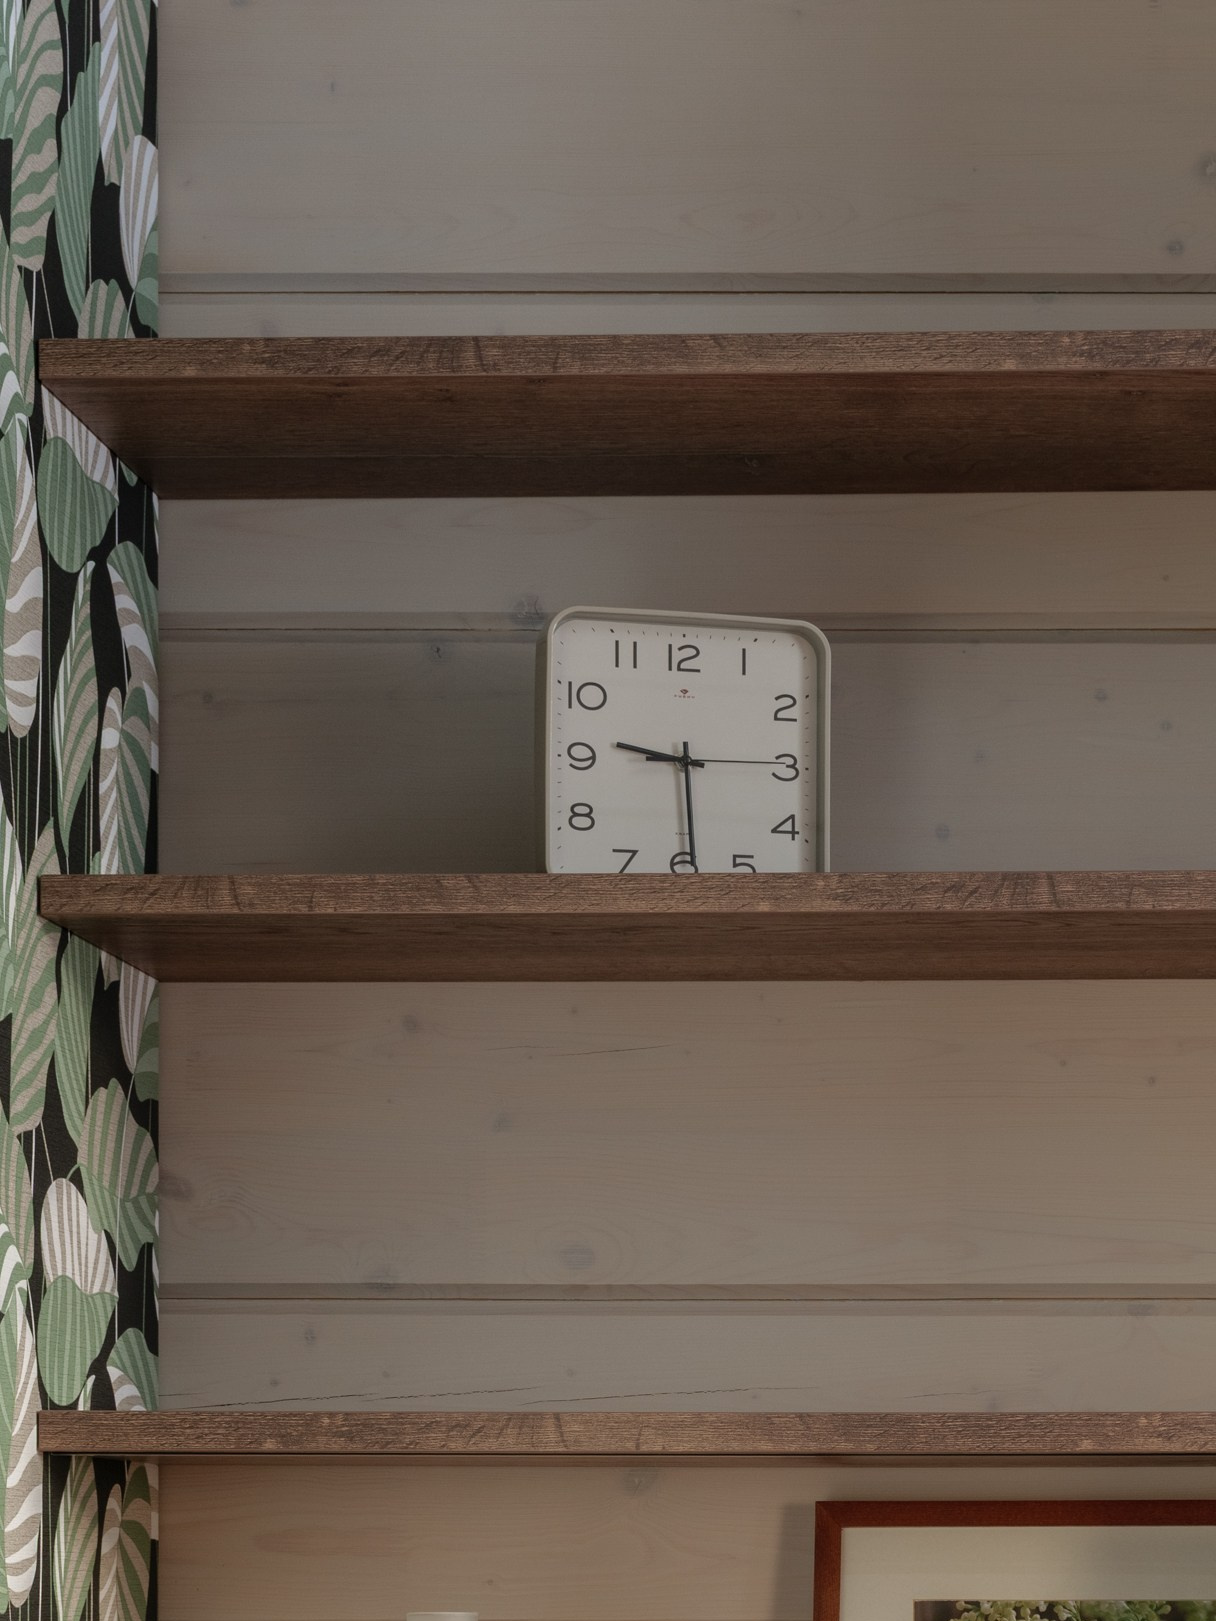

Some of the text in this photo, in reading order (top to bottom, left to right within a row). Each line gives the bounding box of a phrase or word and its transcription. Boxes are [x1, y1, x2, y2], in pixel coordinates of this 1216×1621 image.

[614, 639, 638, 669] 11
[667, 643, 701, 673] 12
[741, 647, 747, 676] 1
[567, 680, 608, 711] 10
[773, 693, 798, 723] 2
[566, 741, 597, 771] 9
[771, 753, 800, 782] 3
[567, 802, 596, 832] 8
[770, 813, 800, 842] 4
[612, 848, 640, 873] 7
[731, 853, 757, 873] 5
